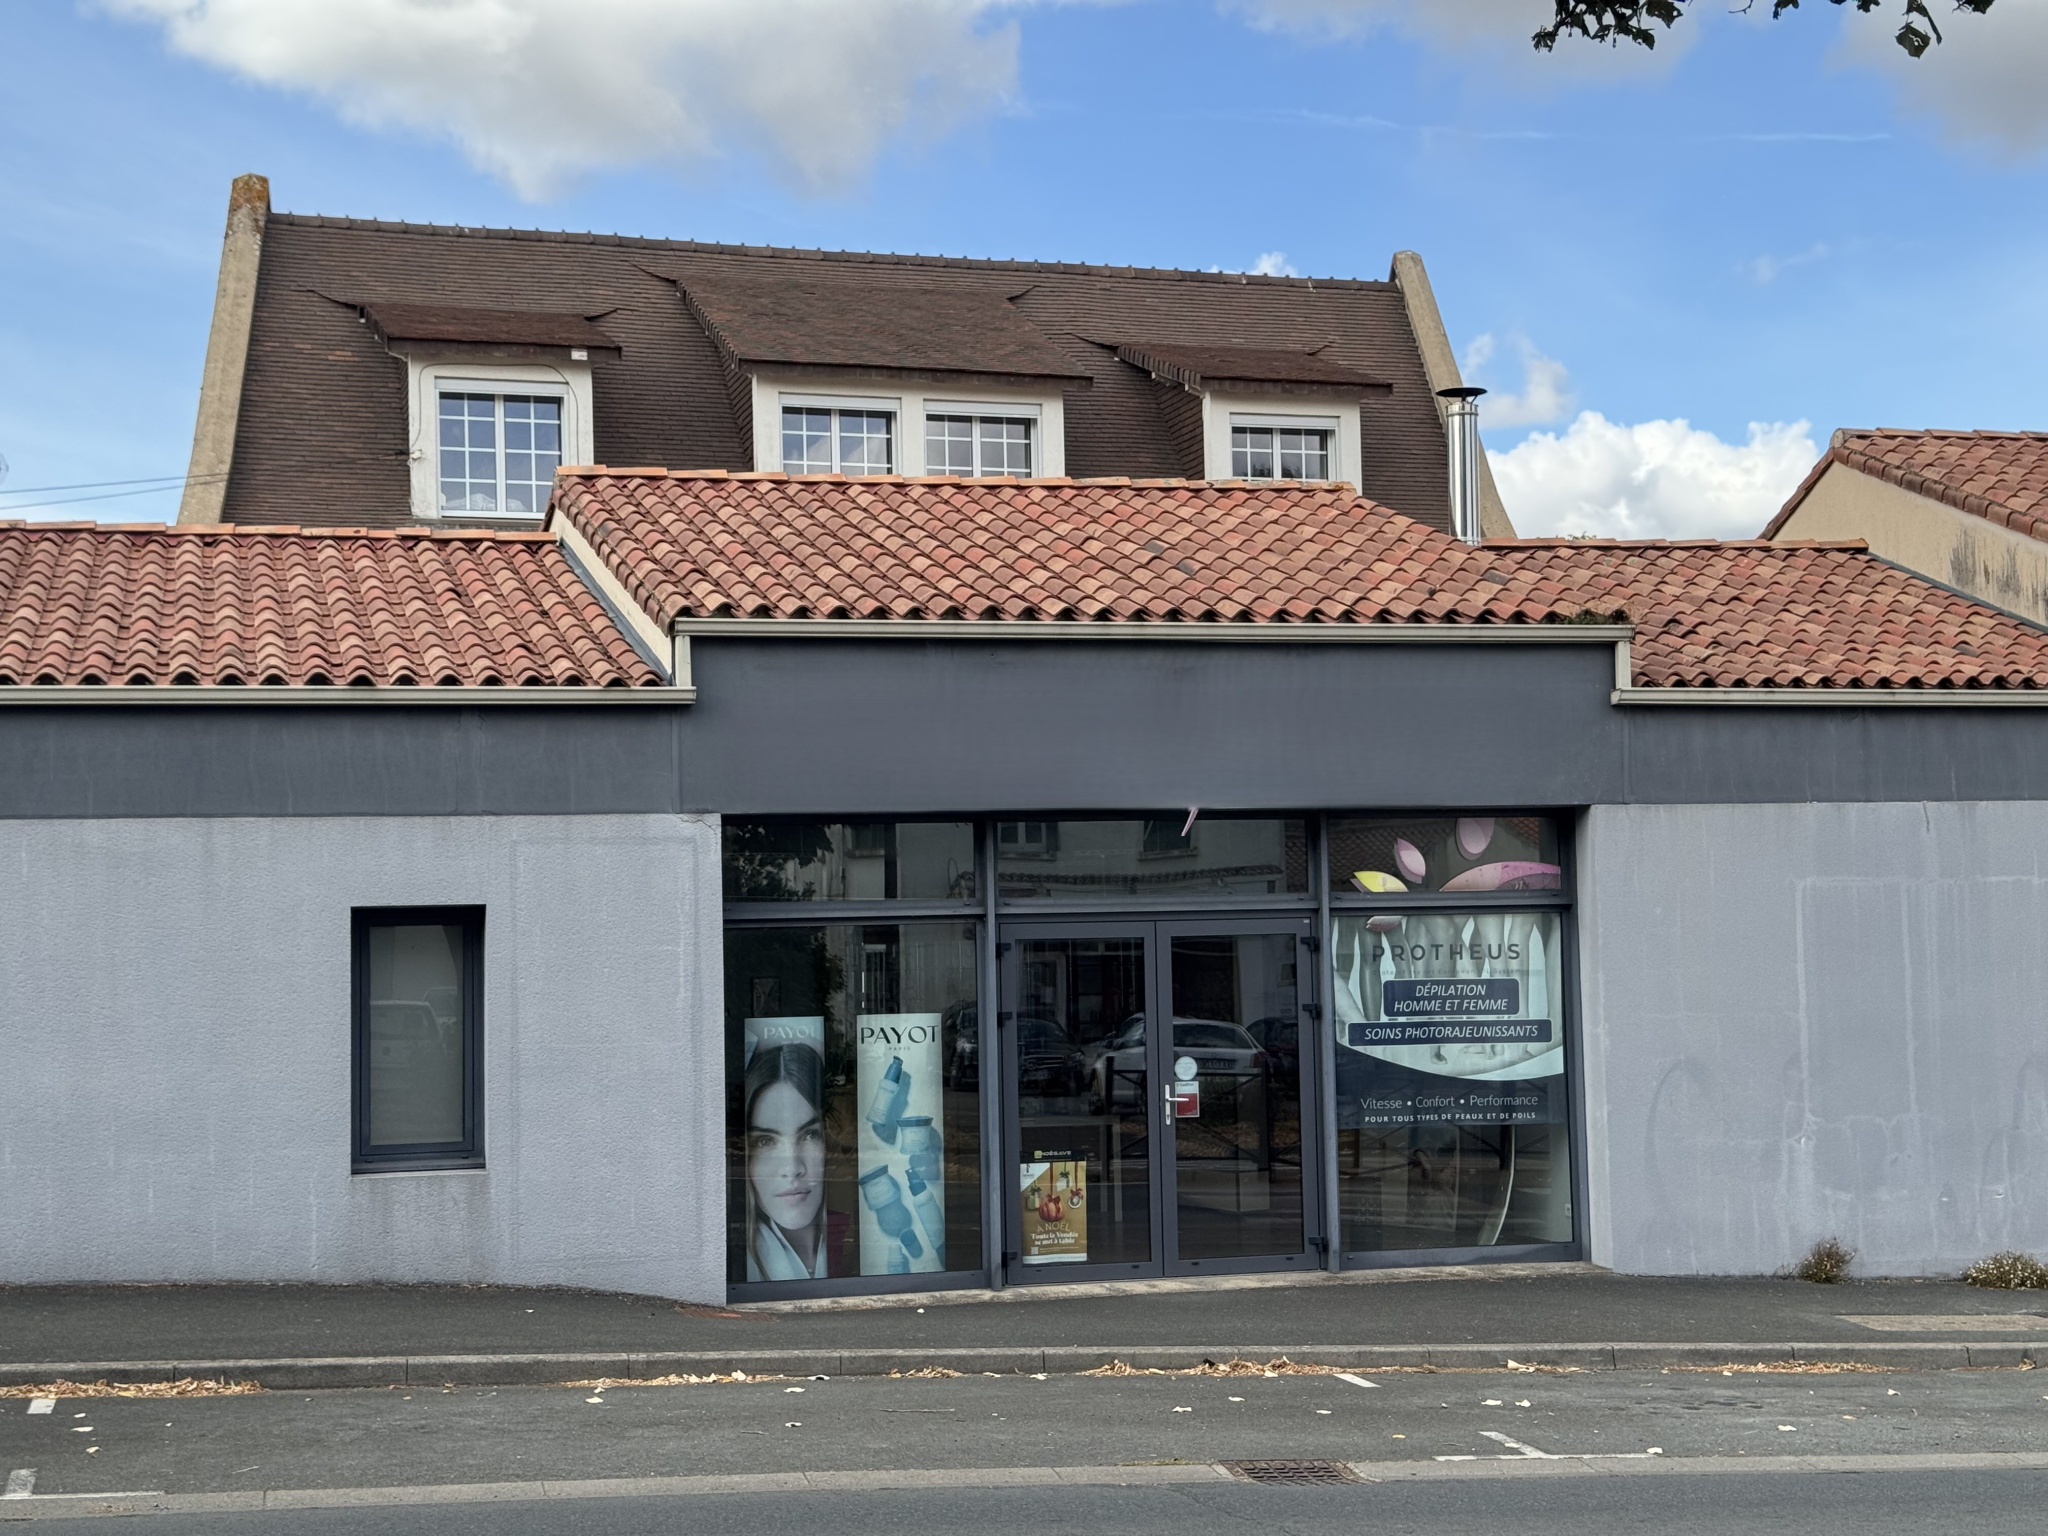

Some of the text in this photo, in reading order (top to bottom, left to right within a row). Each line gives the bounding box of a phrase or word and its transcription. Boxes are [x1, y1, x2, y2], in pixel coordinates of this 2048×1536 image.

[1372, 943, 1521, 962] PROTHEUS
[1415, 982, 1487, 997] DÉPILATION
[1394, 998, 1508, 1012] HOMME ET FEMME
[763, 1025, 817, 1040] PAYOT
[860, 1025, 940, 1045] PAYOT
[1364, 1025, 1539, 1040] SOINS PHOTORAJEUNISSANTS
[1360, 1094, 1539, 1110] Vitesse Confort Performance
[1364, 1115, 1389, 1123] POUR
[1392, 1114, 1414, 1122] TOUS
[1500, 1112, 1510, 1120] DE
